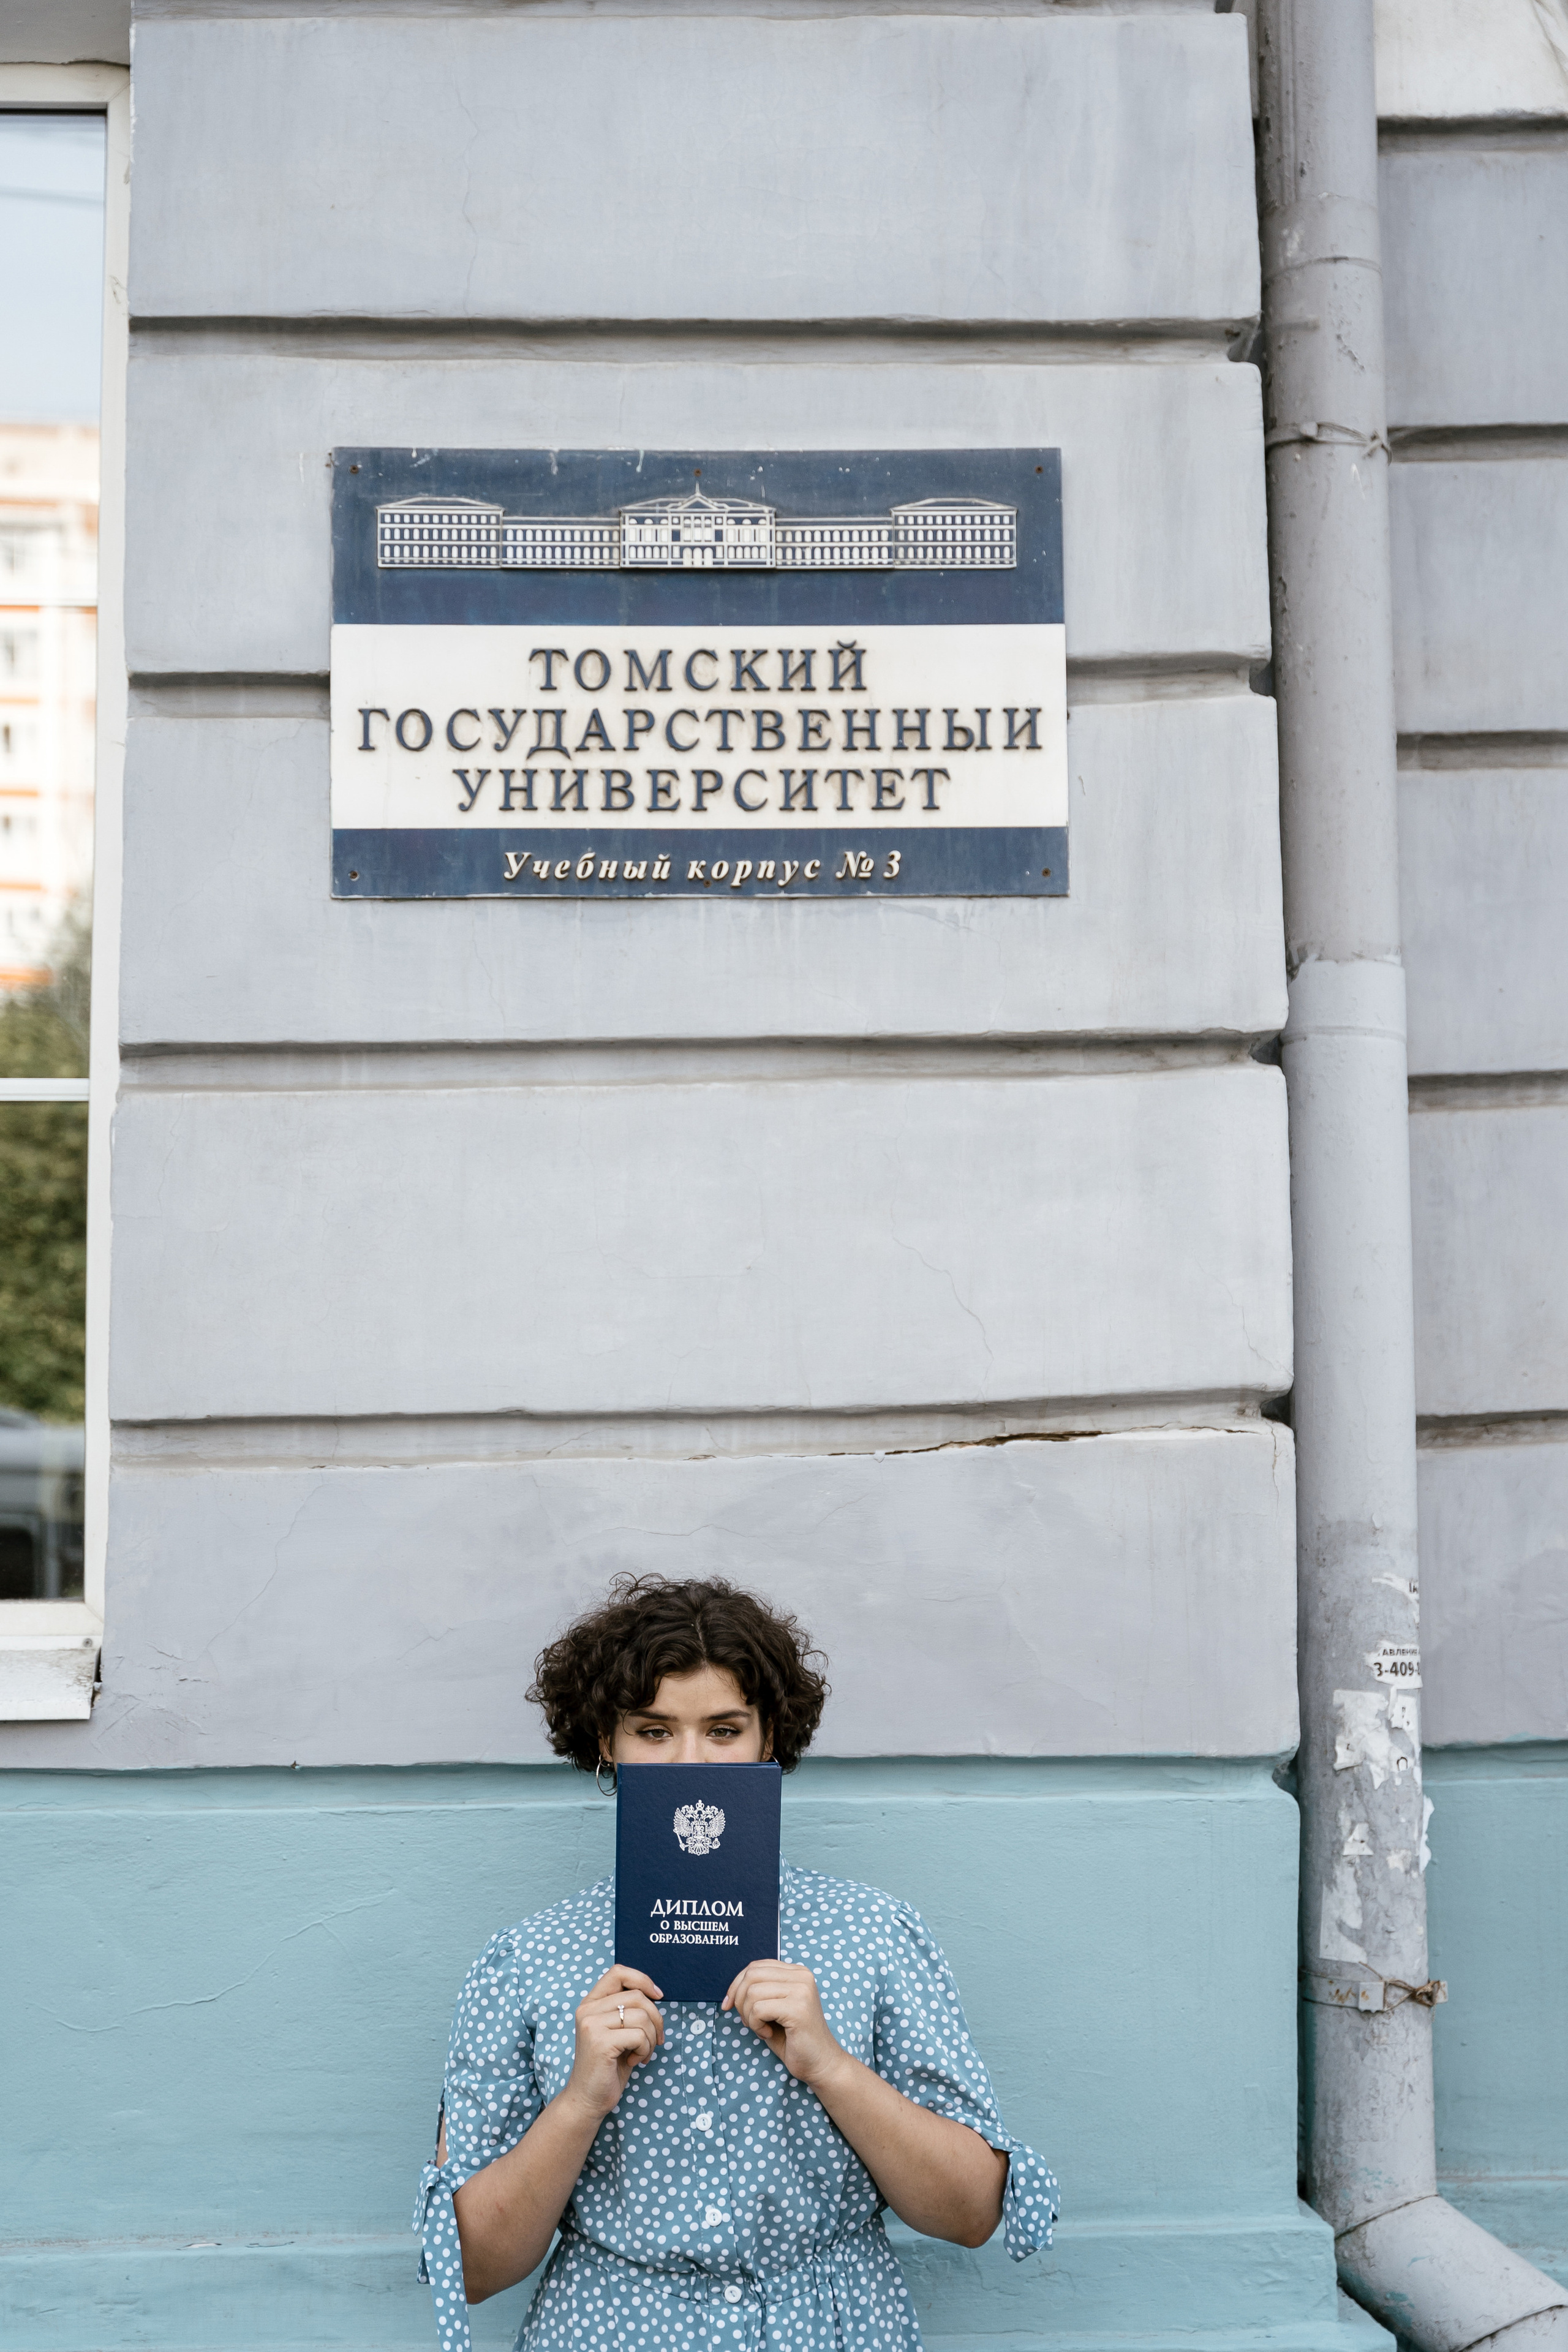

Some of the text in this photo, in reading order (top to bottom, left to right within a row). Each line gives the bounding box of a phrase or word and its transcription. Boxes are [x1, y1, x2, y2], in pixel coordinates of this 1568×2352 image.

[528, 640, 867, 692] ТОМСКИЙ
[451, 767, 951, 812] УНИВЕРСИТЕТ
[503, 850, 671, 880] Учебный
[687, 858, 821, 887] корпус
[882, 850, 902, 878] 3
[649, 1899, 744, 1918] ДИПЛОМ
[649, 1933, 739, 1945] ОБРАЗОВАНИИ
[660, 1920, 729, 1932] О ВЫСШЕМ
